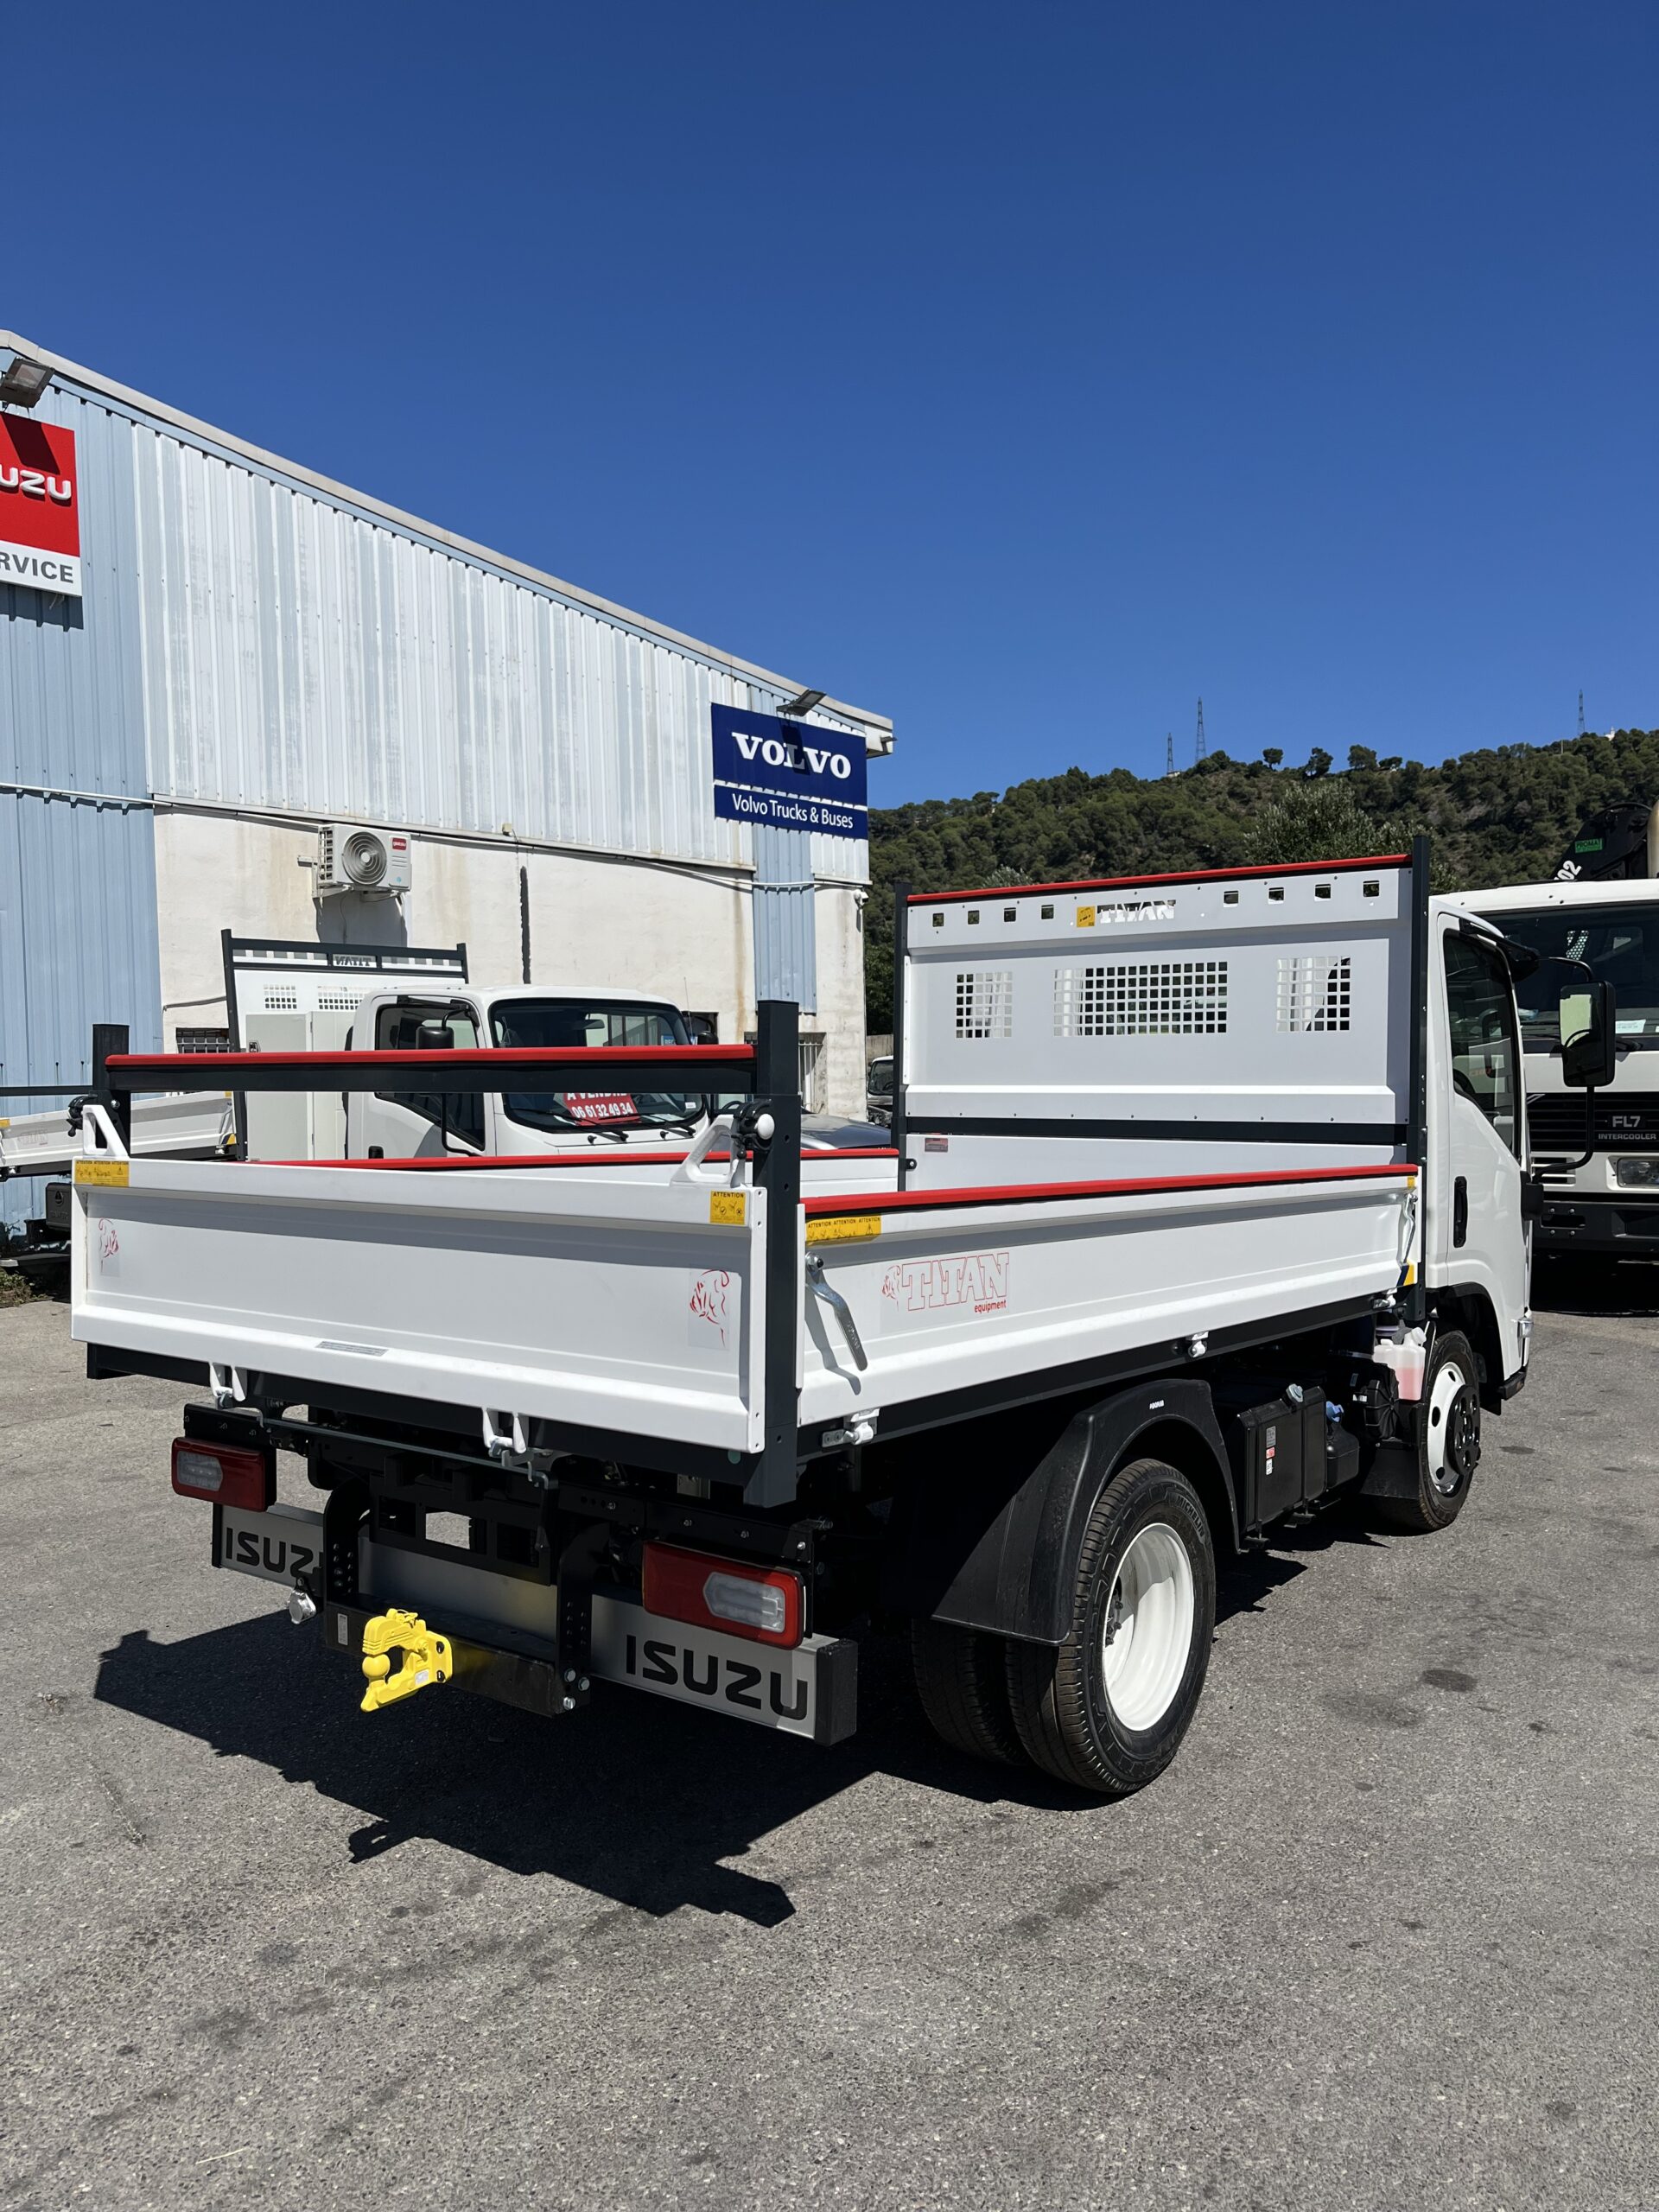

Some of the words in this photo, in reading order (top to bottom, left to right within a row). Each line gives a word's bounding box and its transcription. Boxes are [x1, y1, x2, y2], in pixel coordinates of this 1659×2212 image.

[731, 731, 852, 779] VOLVO
[732, 793, 768, 816] Volvo
[769, 799, 807, 822] Trucks
[810, 806, 819, 823] &
[821, 808, 854, 830] Buses
[1554, 860, 1582, 880] 02
[1096, 899, 1177, 924] TITAN
[571, 1106, 587, 1119] 06
[585, 1104, 598, 1118] 61
[595, 1103, 610, 1117] 32
[608, 1103, 621, 1116] 49
[620, 1102, 634, 1115] 34
[1612, 1116, 1641, 1128] FL7
[901, 1252, 1010, 1312] TITAN
[974, 1300, 1007, 1314] equipment
[1177, 1495, 1205, 1537] MICHELIN
[226, 1527, 325, 1579] ISUZ
[626, 1634, 809, 1721] ISUZU
